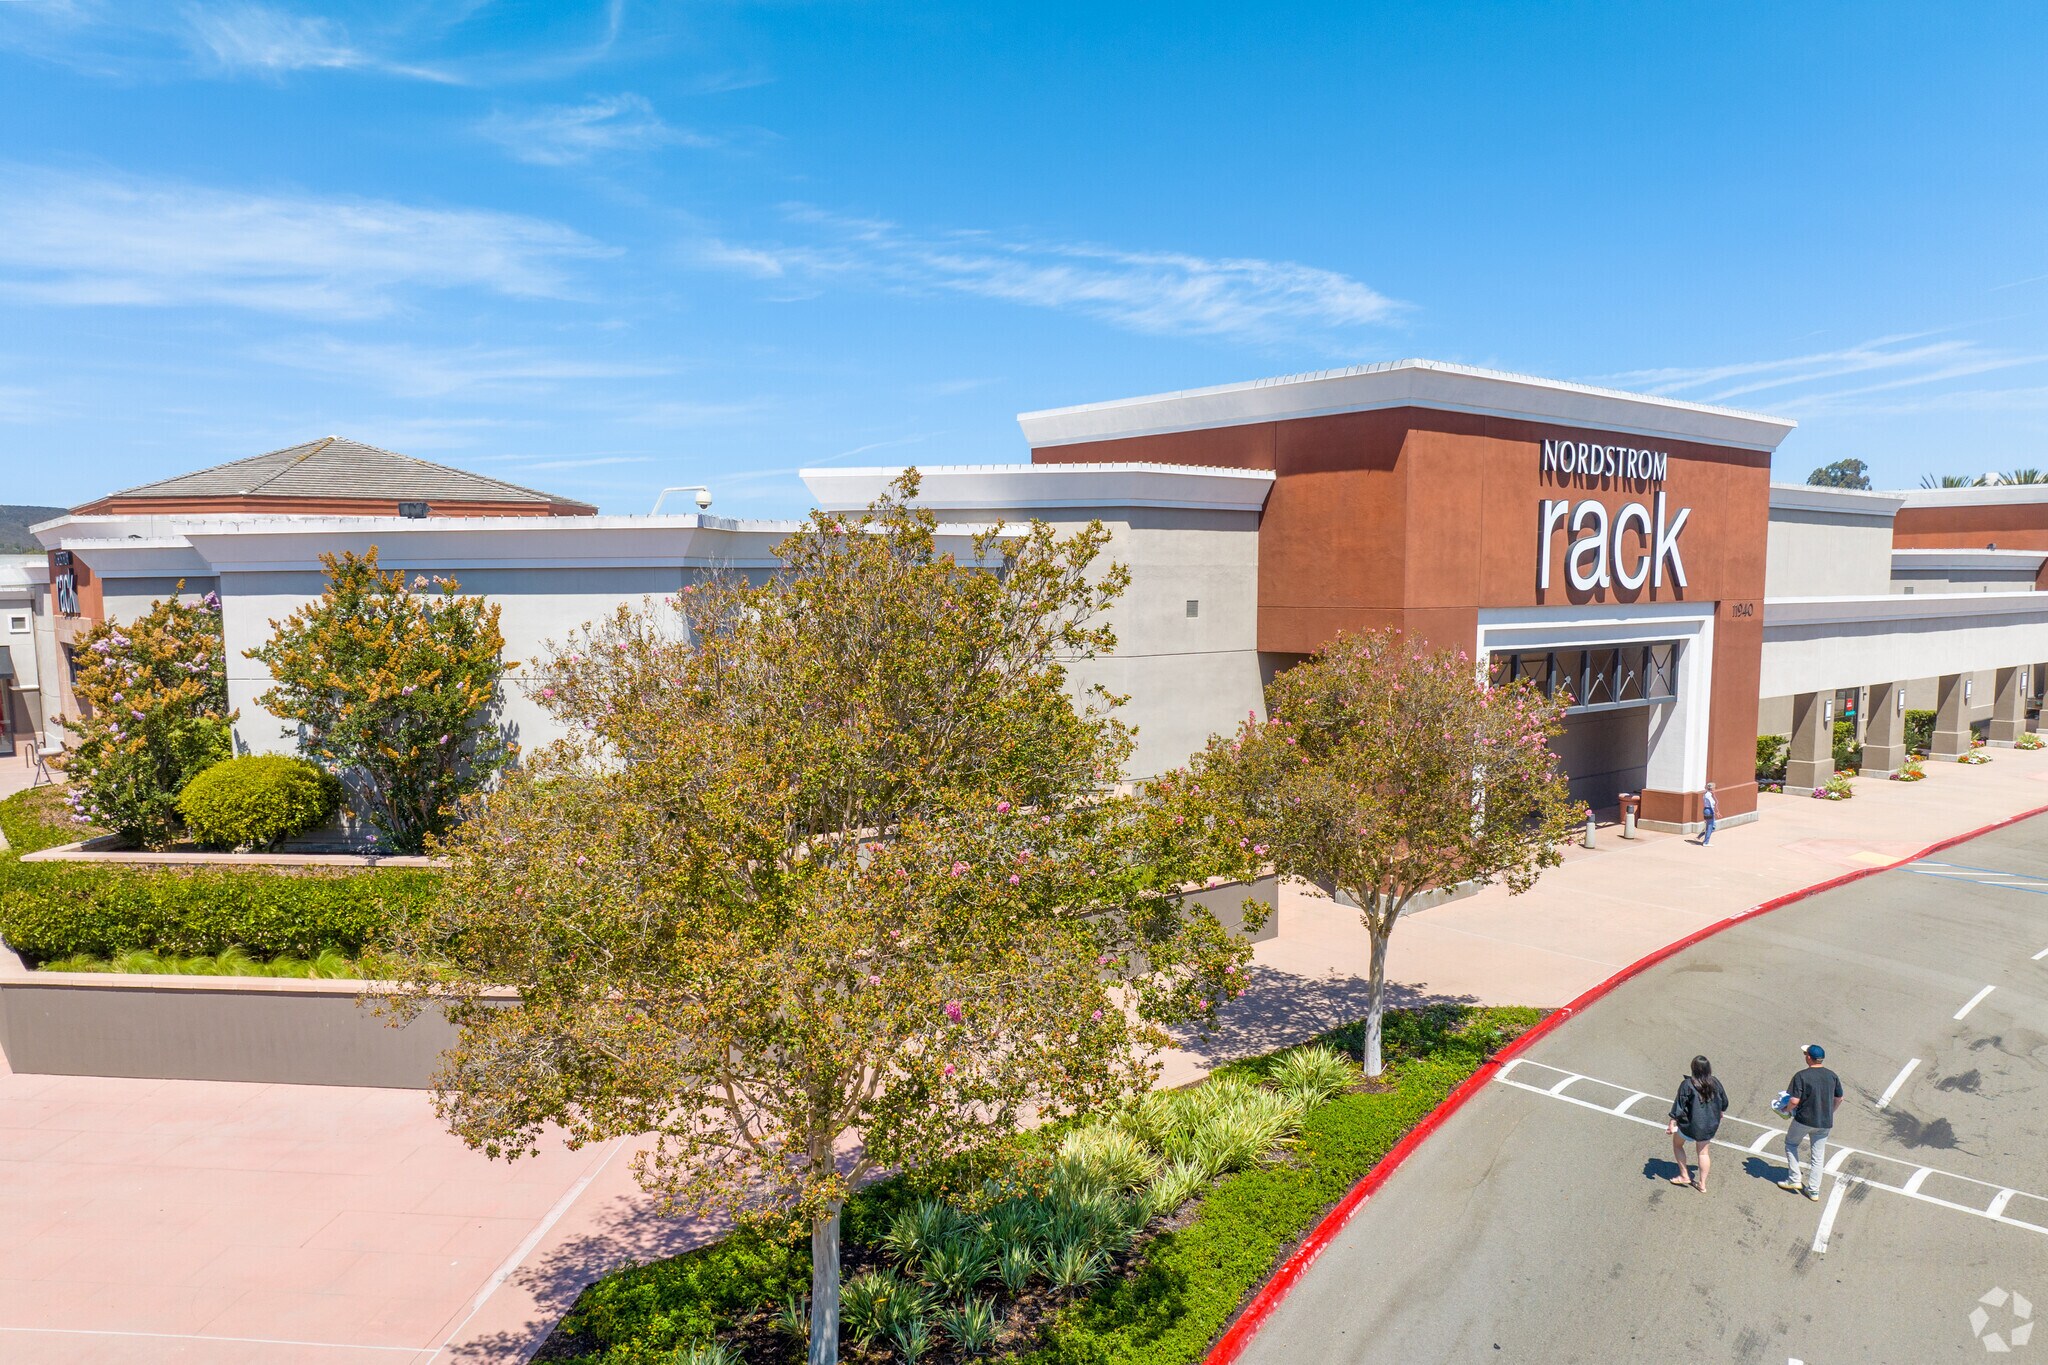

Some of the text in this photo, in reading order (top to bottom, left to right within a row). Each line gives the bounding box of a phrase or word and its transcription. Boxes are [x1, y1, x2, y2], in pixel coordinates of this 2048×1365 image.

[1543, 439, 1668, 482] NORDSTROM
[1541, 491, 1692, 591] rack
[56, 568, 77, 613] rack
[1732, 603, 1754, 618] 11940
